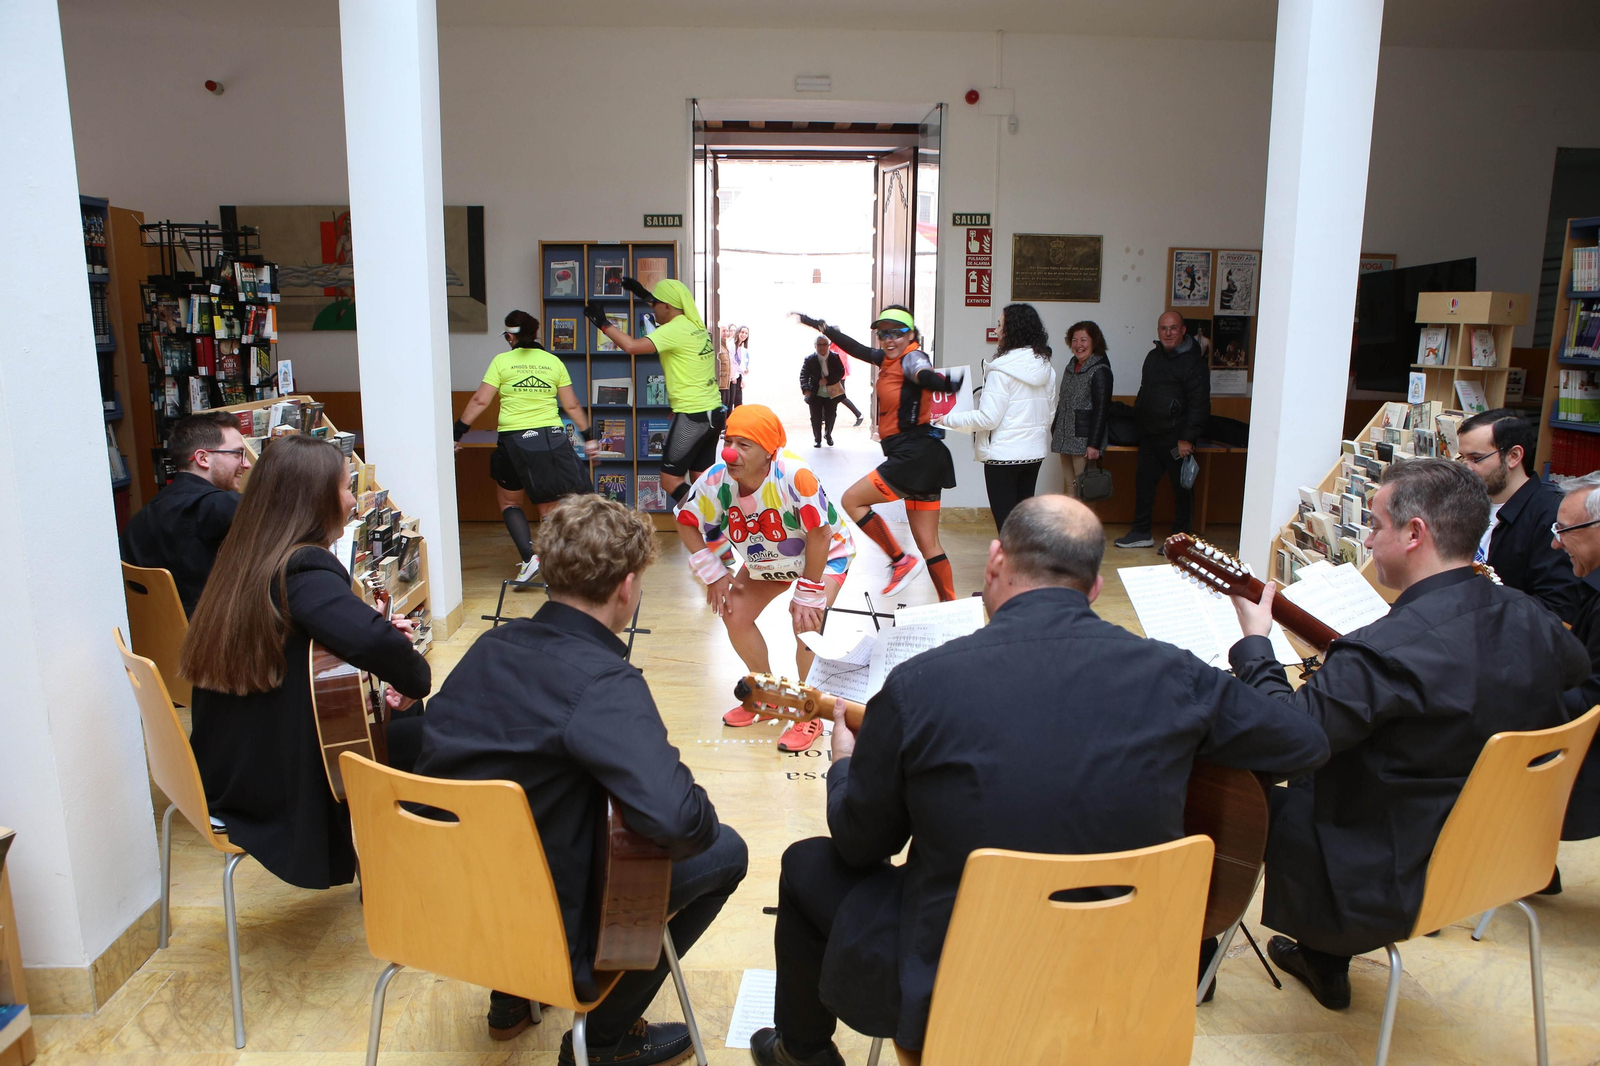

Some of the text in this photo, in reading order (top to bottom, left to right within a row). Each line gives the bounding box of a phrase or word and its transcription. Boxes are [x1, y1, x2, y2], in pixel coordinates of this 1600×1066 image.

[646, 216, 680, 226] SALIDA
[955, 215, 988, 225] SALIDA
[1362, 262, 1383, 271] YOGA
[598, 475, 625, 484] ARTE
